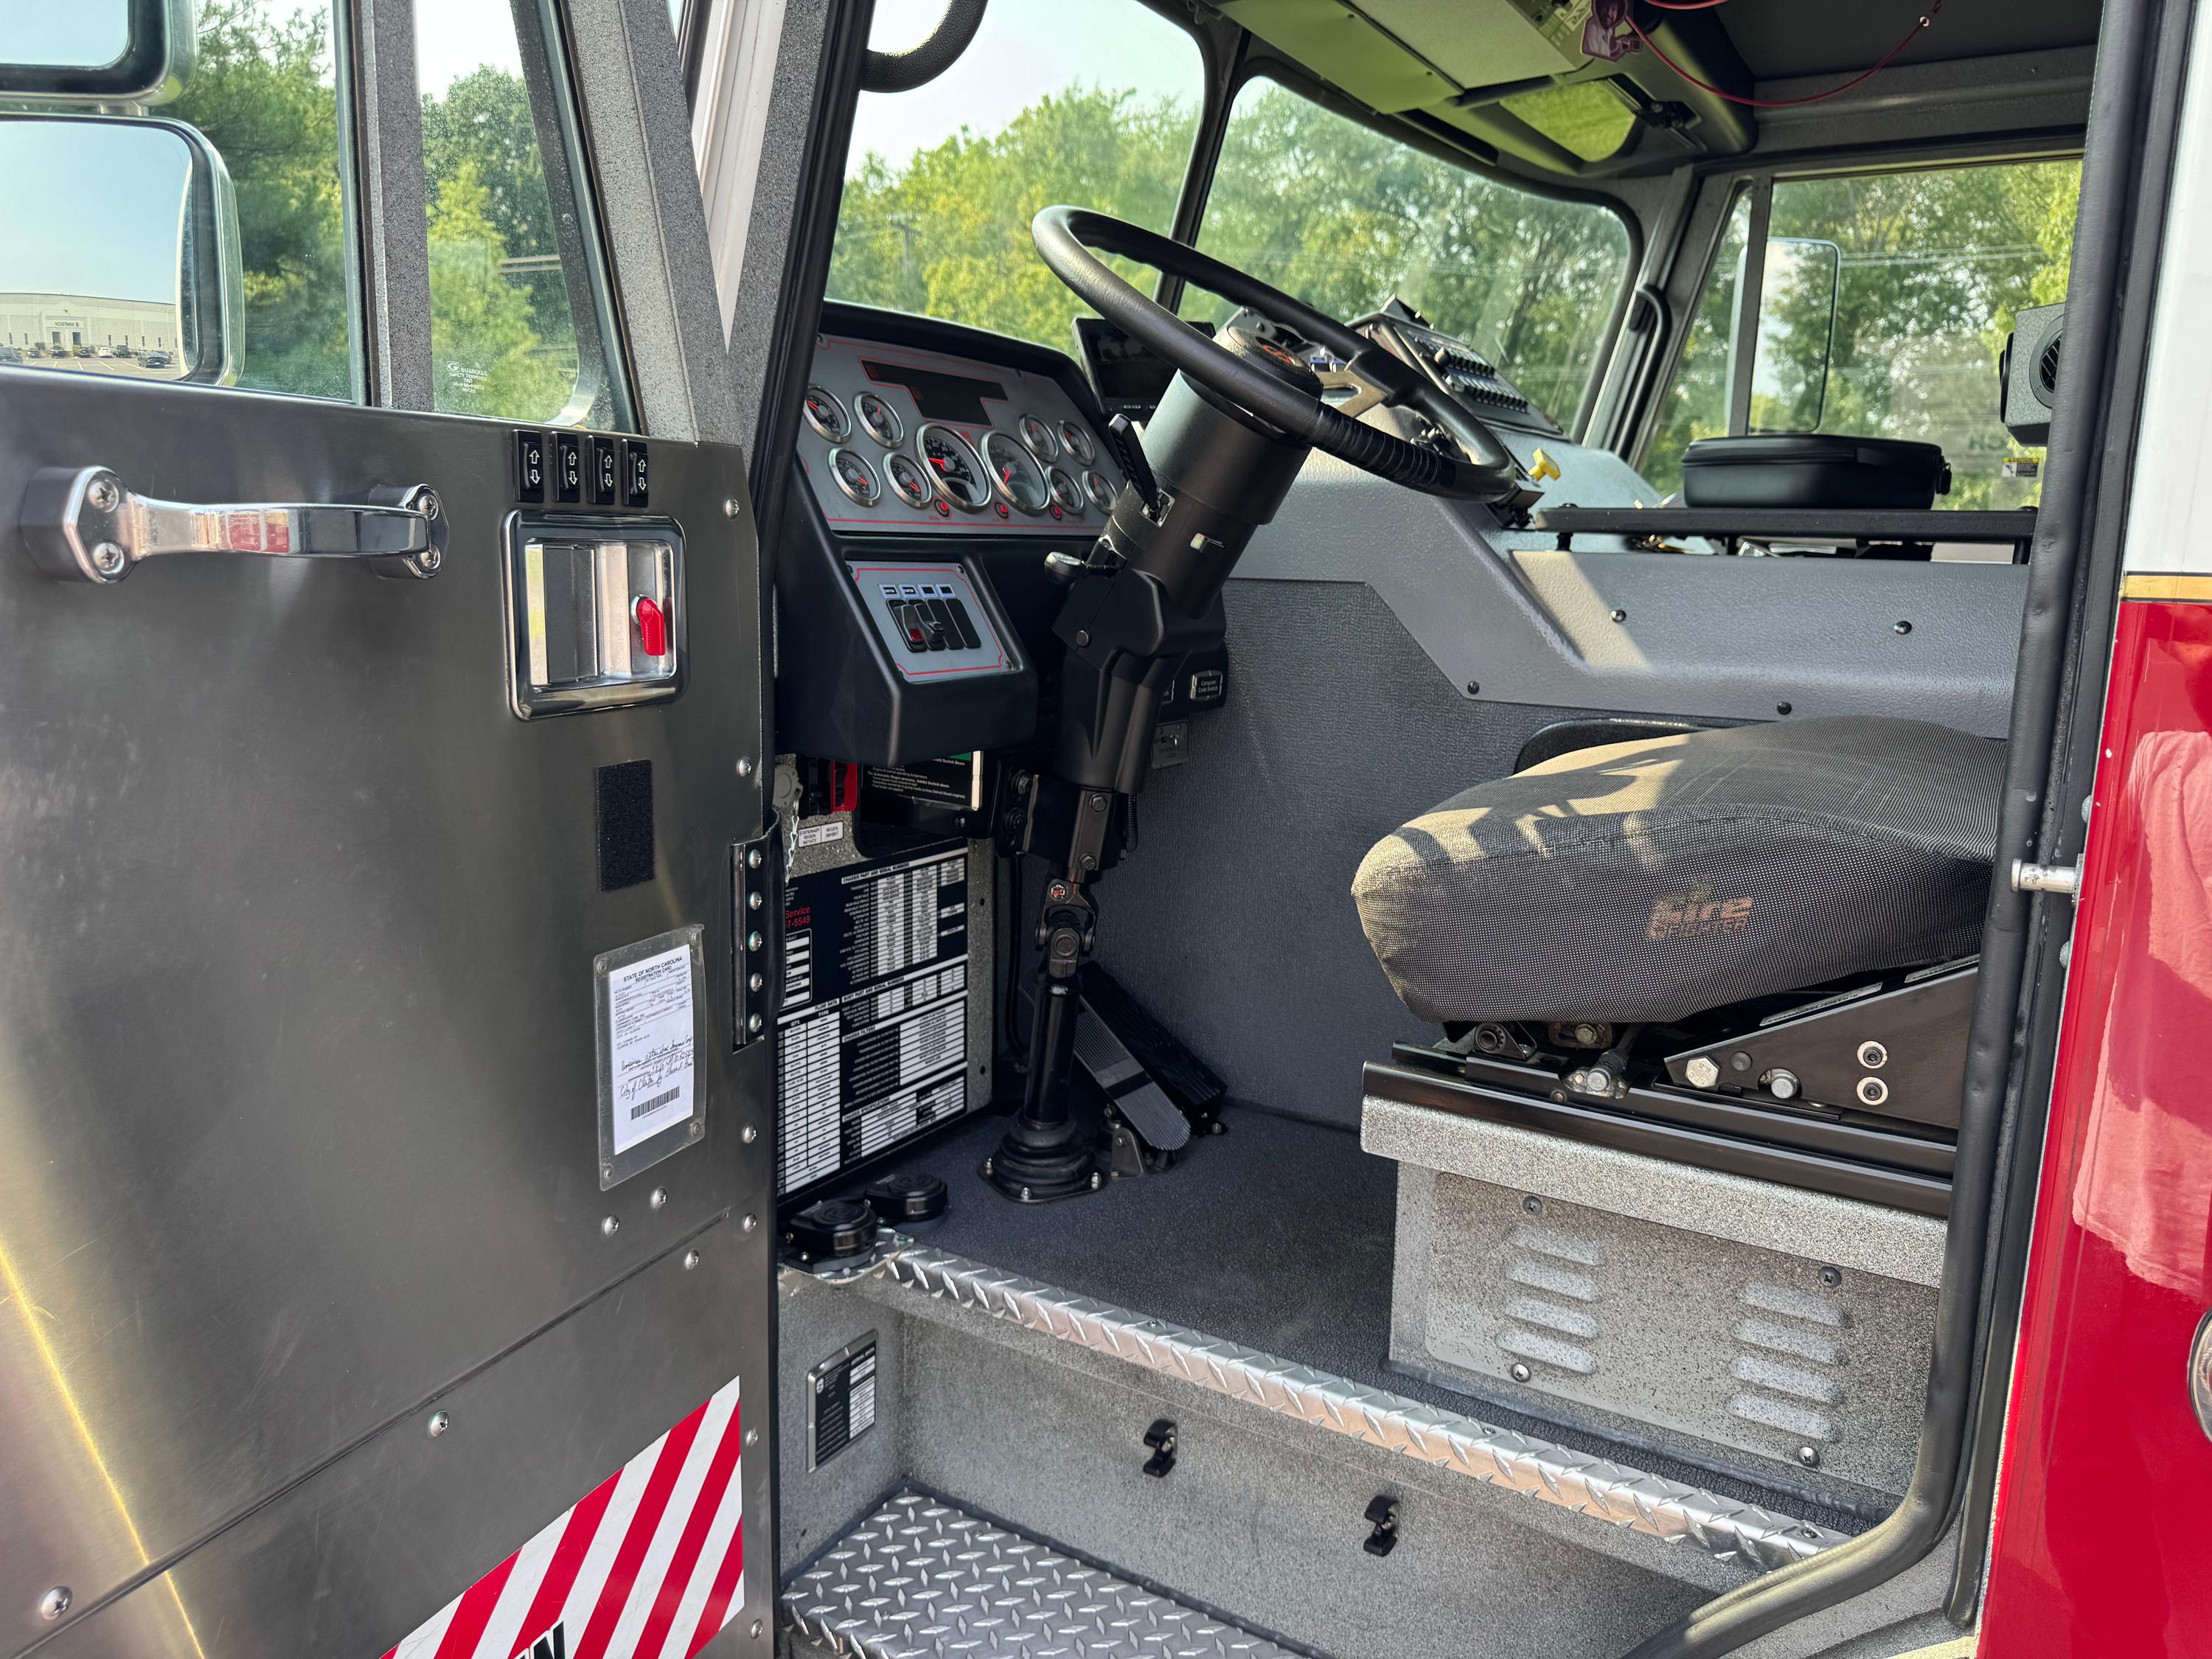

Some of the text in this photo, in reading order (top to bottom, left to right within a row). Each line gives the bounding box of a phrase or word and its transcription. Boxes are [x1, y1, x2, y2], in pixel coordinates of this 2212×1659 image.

[461, 367, 488, 377] GUARDIAN
[843, 862, 910, 883] CHASSIS PART AND SERIAL NUMBERS
[785, 906, 810, 919] Service
[623, 973, 638, 982] STATE
[646, 964, 661, 973] NORTH
[661, 956, 683, 968] CAROLINA
[636, 970, 661, 983] REGISTRATION
